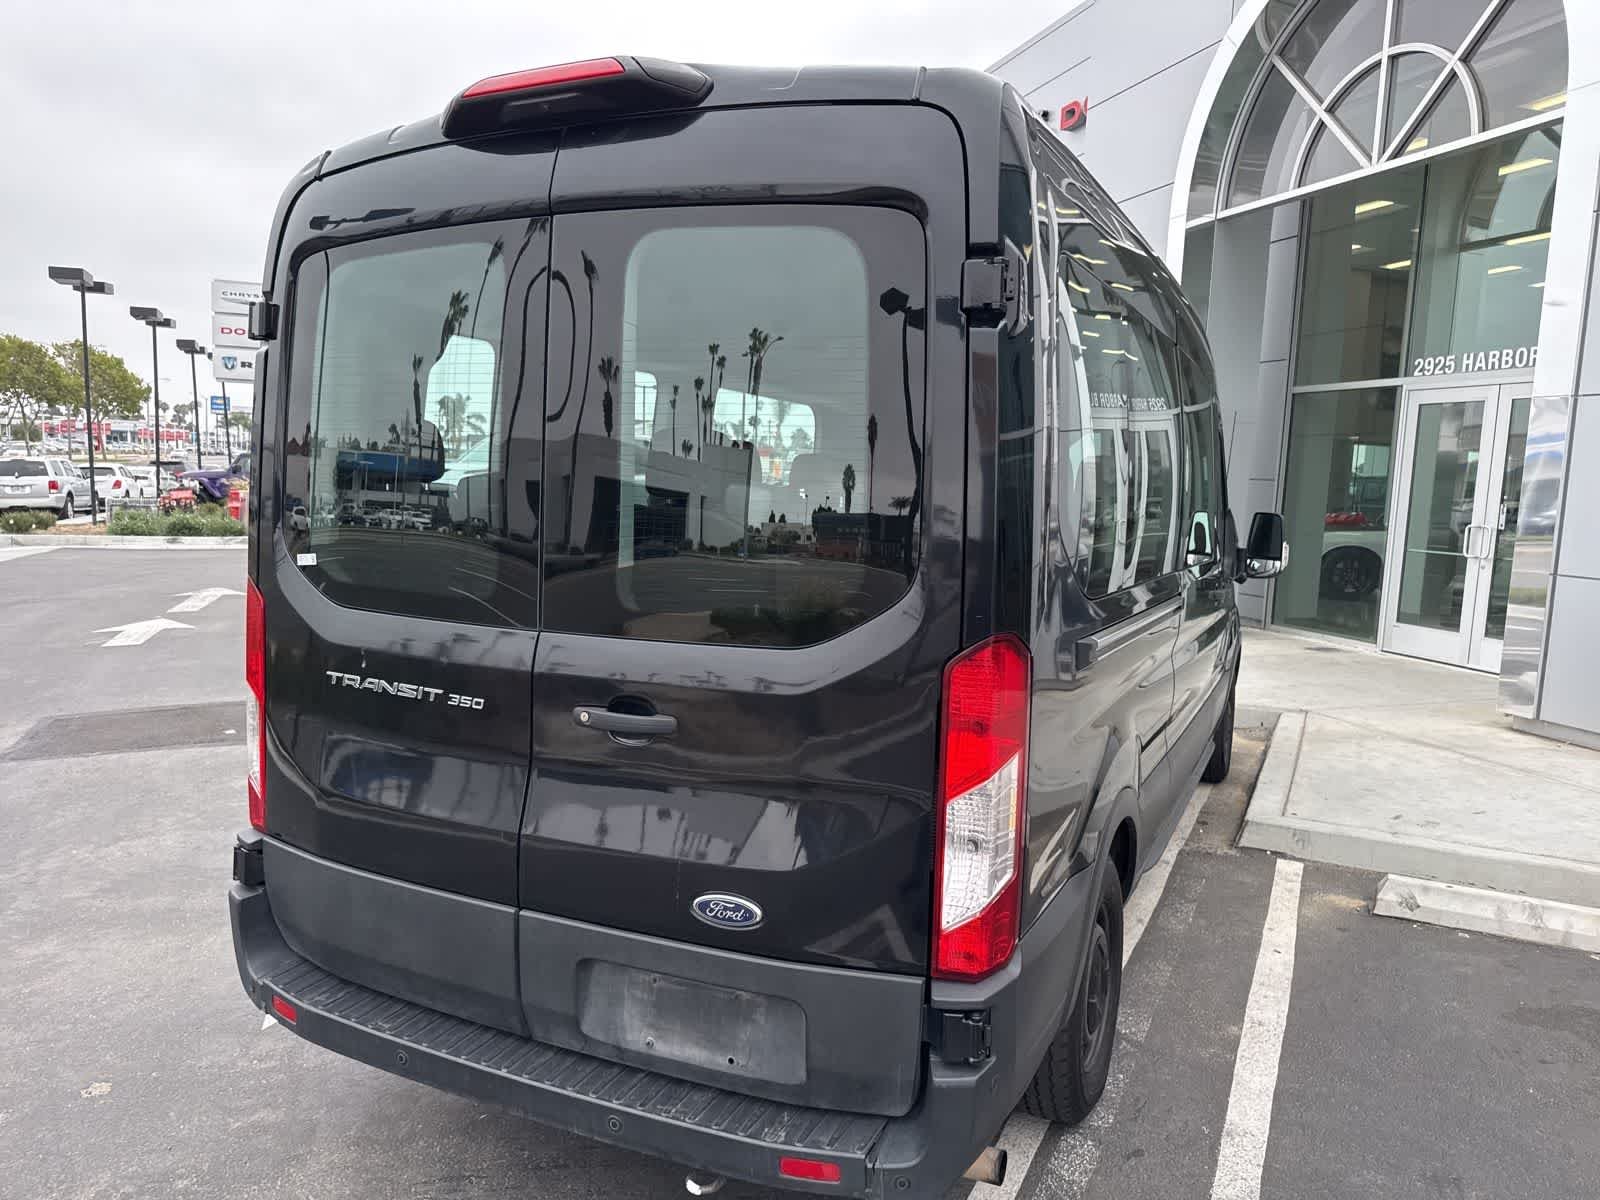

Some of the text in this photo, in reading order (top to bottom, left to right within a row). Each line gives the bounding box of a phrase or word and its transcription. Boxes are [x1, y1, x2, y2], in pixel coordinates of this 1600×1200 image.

[1413, 355, 1456, 376] 2925
[326, 670, 485, 710] TRANSIT 350
[706, 900, 745, 921] Ford
